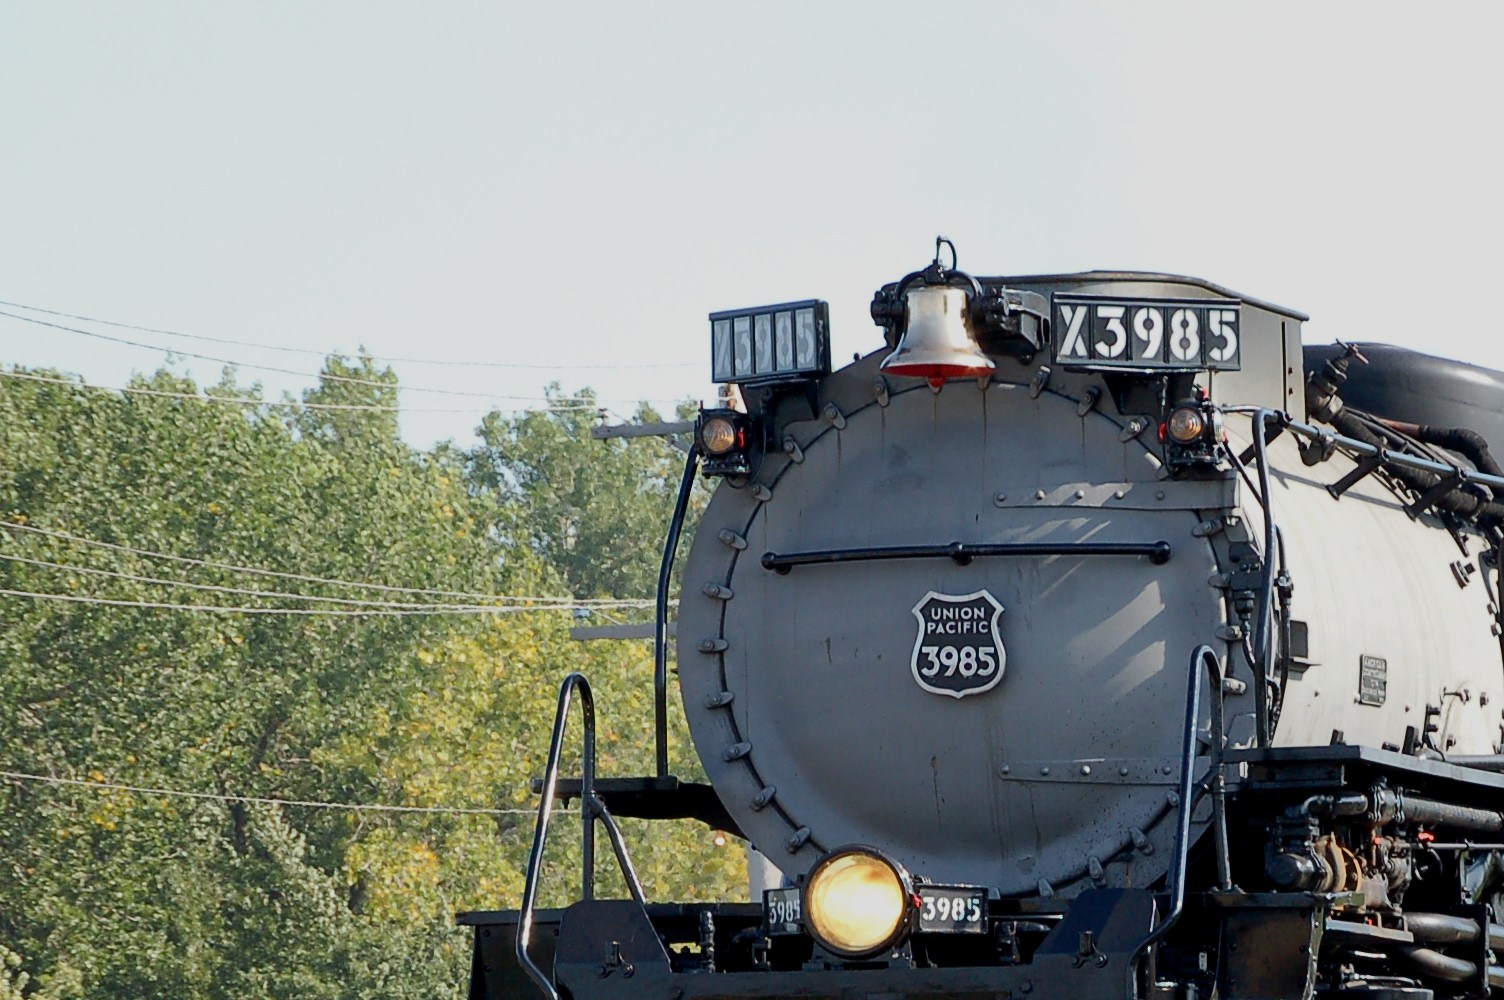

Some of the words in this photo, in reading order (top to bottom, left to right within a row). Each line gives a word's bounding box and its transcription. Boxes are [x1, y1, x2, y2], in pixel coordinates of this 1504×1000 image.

[1058, 304, 1238, 362] X3985
[931, 607, 985, 620] UNION
[927, 621, 989, 635] PACIFIC
[921, 645, 996, 677] 3985
[922, 896, 980, 922] 3985
